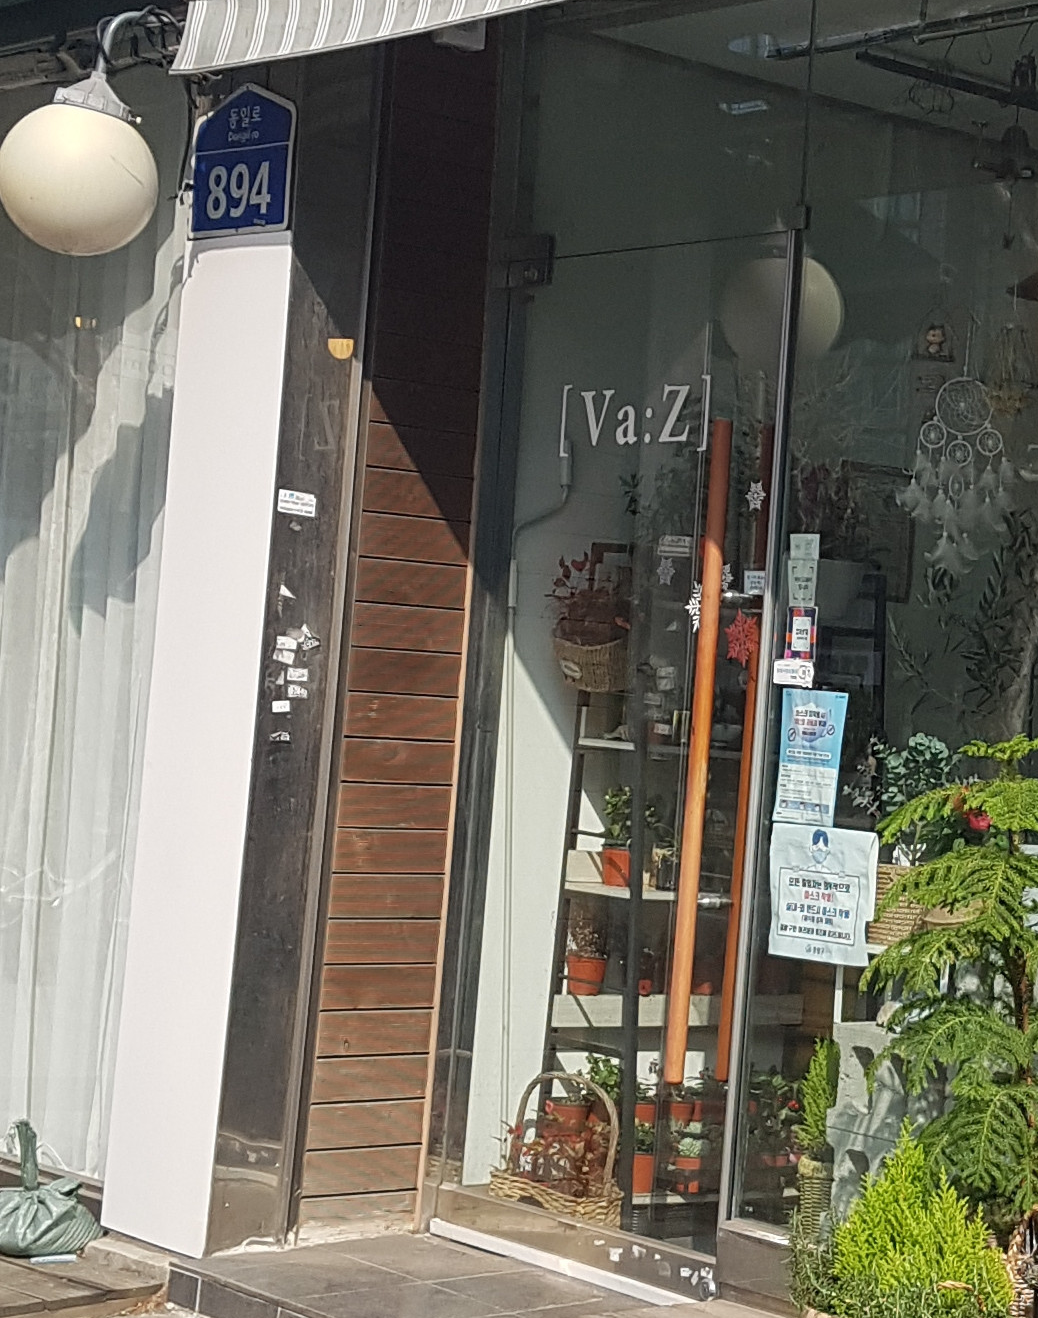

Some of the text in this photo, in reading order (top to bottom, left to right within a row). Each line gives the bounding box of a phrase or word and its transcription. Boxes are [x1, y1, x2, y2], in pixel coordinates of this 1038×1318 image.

[228, 106, 261, 129] 동일로
[206, 160, 271, 220] 894
[559, 375, 711, 457] [Va:Z]
